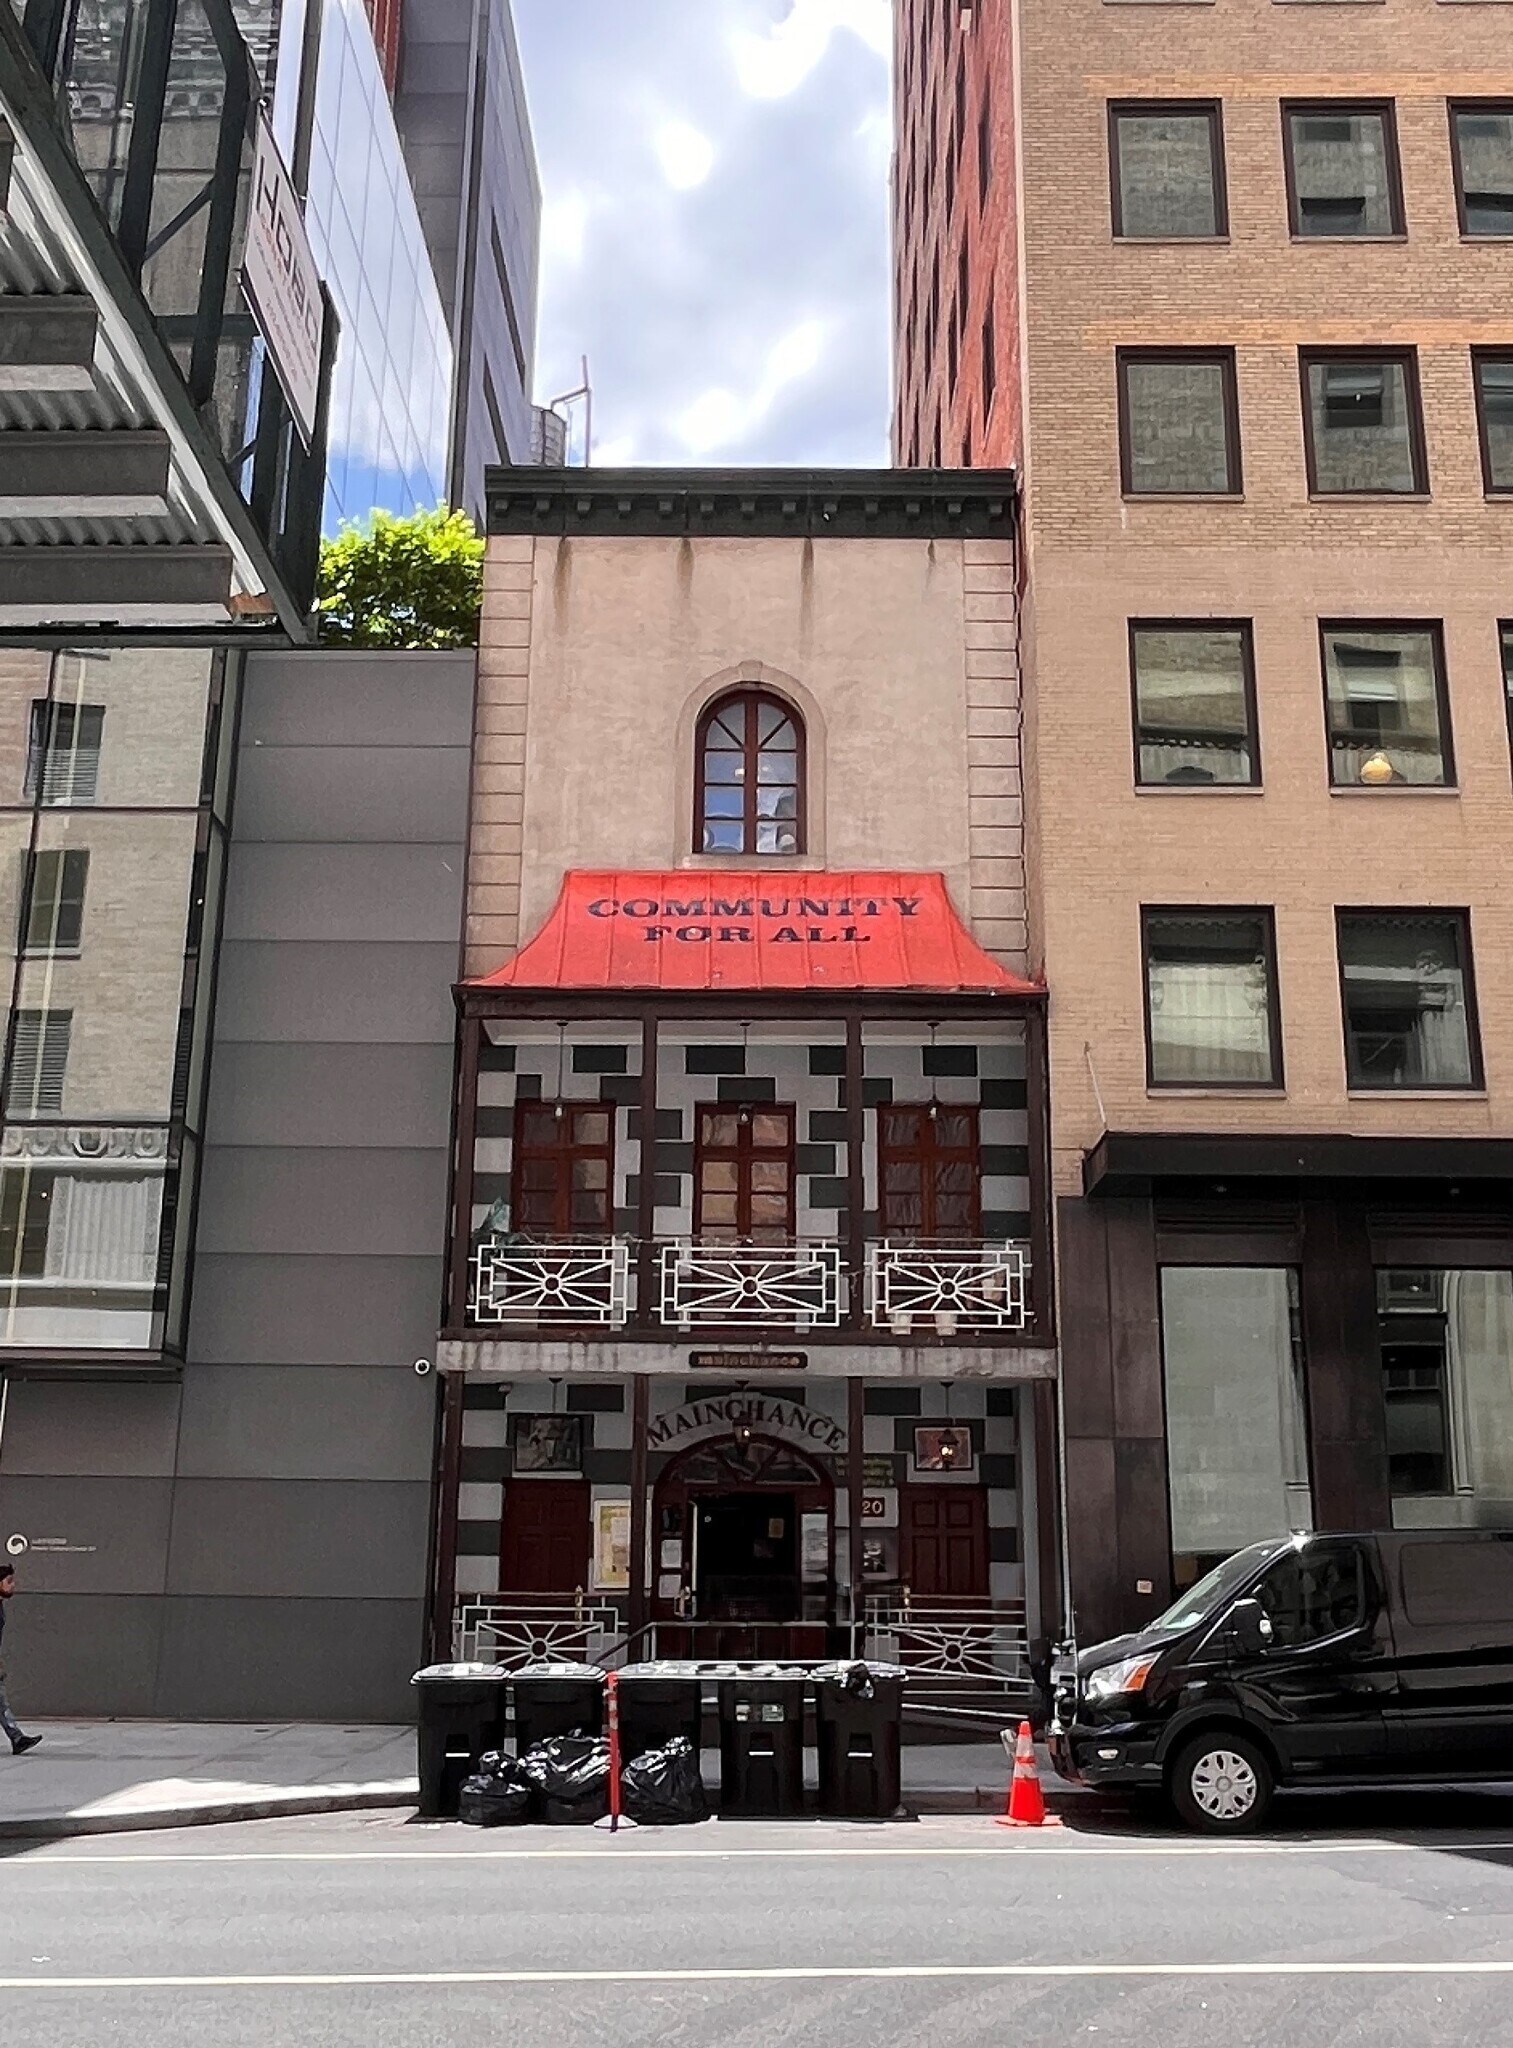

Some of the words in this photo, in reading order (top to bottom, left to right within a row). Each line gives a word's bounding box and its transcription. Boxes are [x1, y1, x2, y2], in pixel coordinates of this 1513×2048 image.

[588, 897, 922, 917] COMMUNITY
[643, 925, 754, 941] FOR
[769, 926, 871, 941] ALL
[647, 1399, 847, 1450] MAINCHANCE
